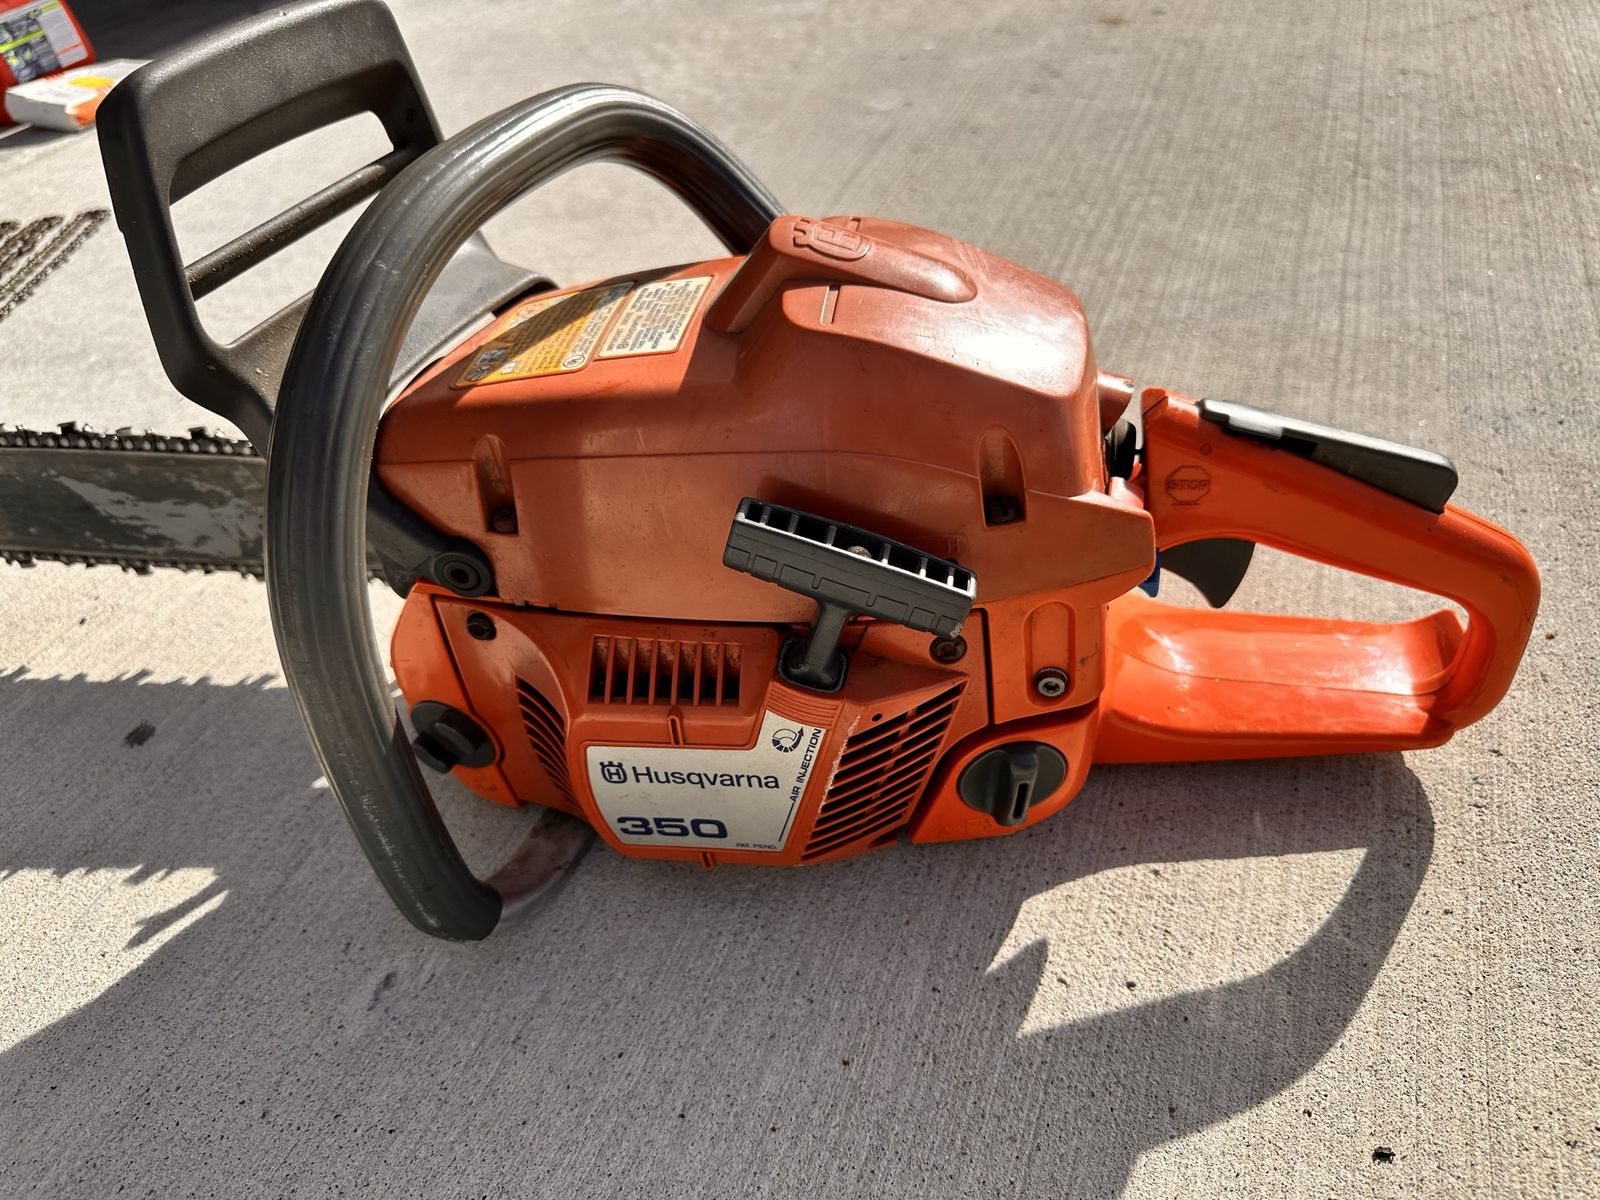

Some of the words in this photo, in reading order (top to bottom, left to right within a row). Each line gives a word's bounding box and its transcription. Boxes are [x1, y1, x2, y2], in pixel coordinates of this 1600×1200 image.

[1167, 479, 1208, 490] STOP
[789, 785, 802, 803] AIR
[798, 728, 821, 784] INJECTION
[632, 766, 780, 789] Husqvarna
[616, 816, 728, 839] 350
